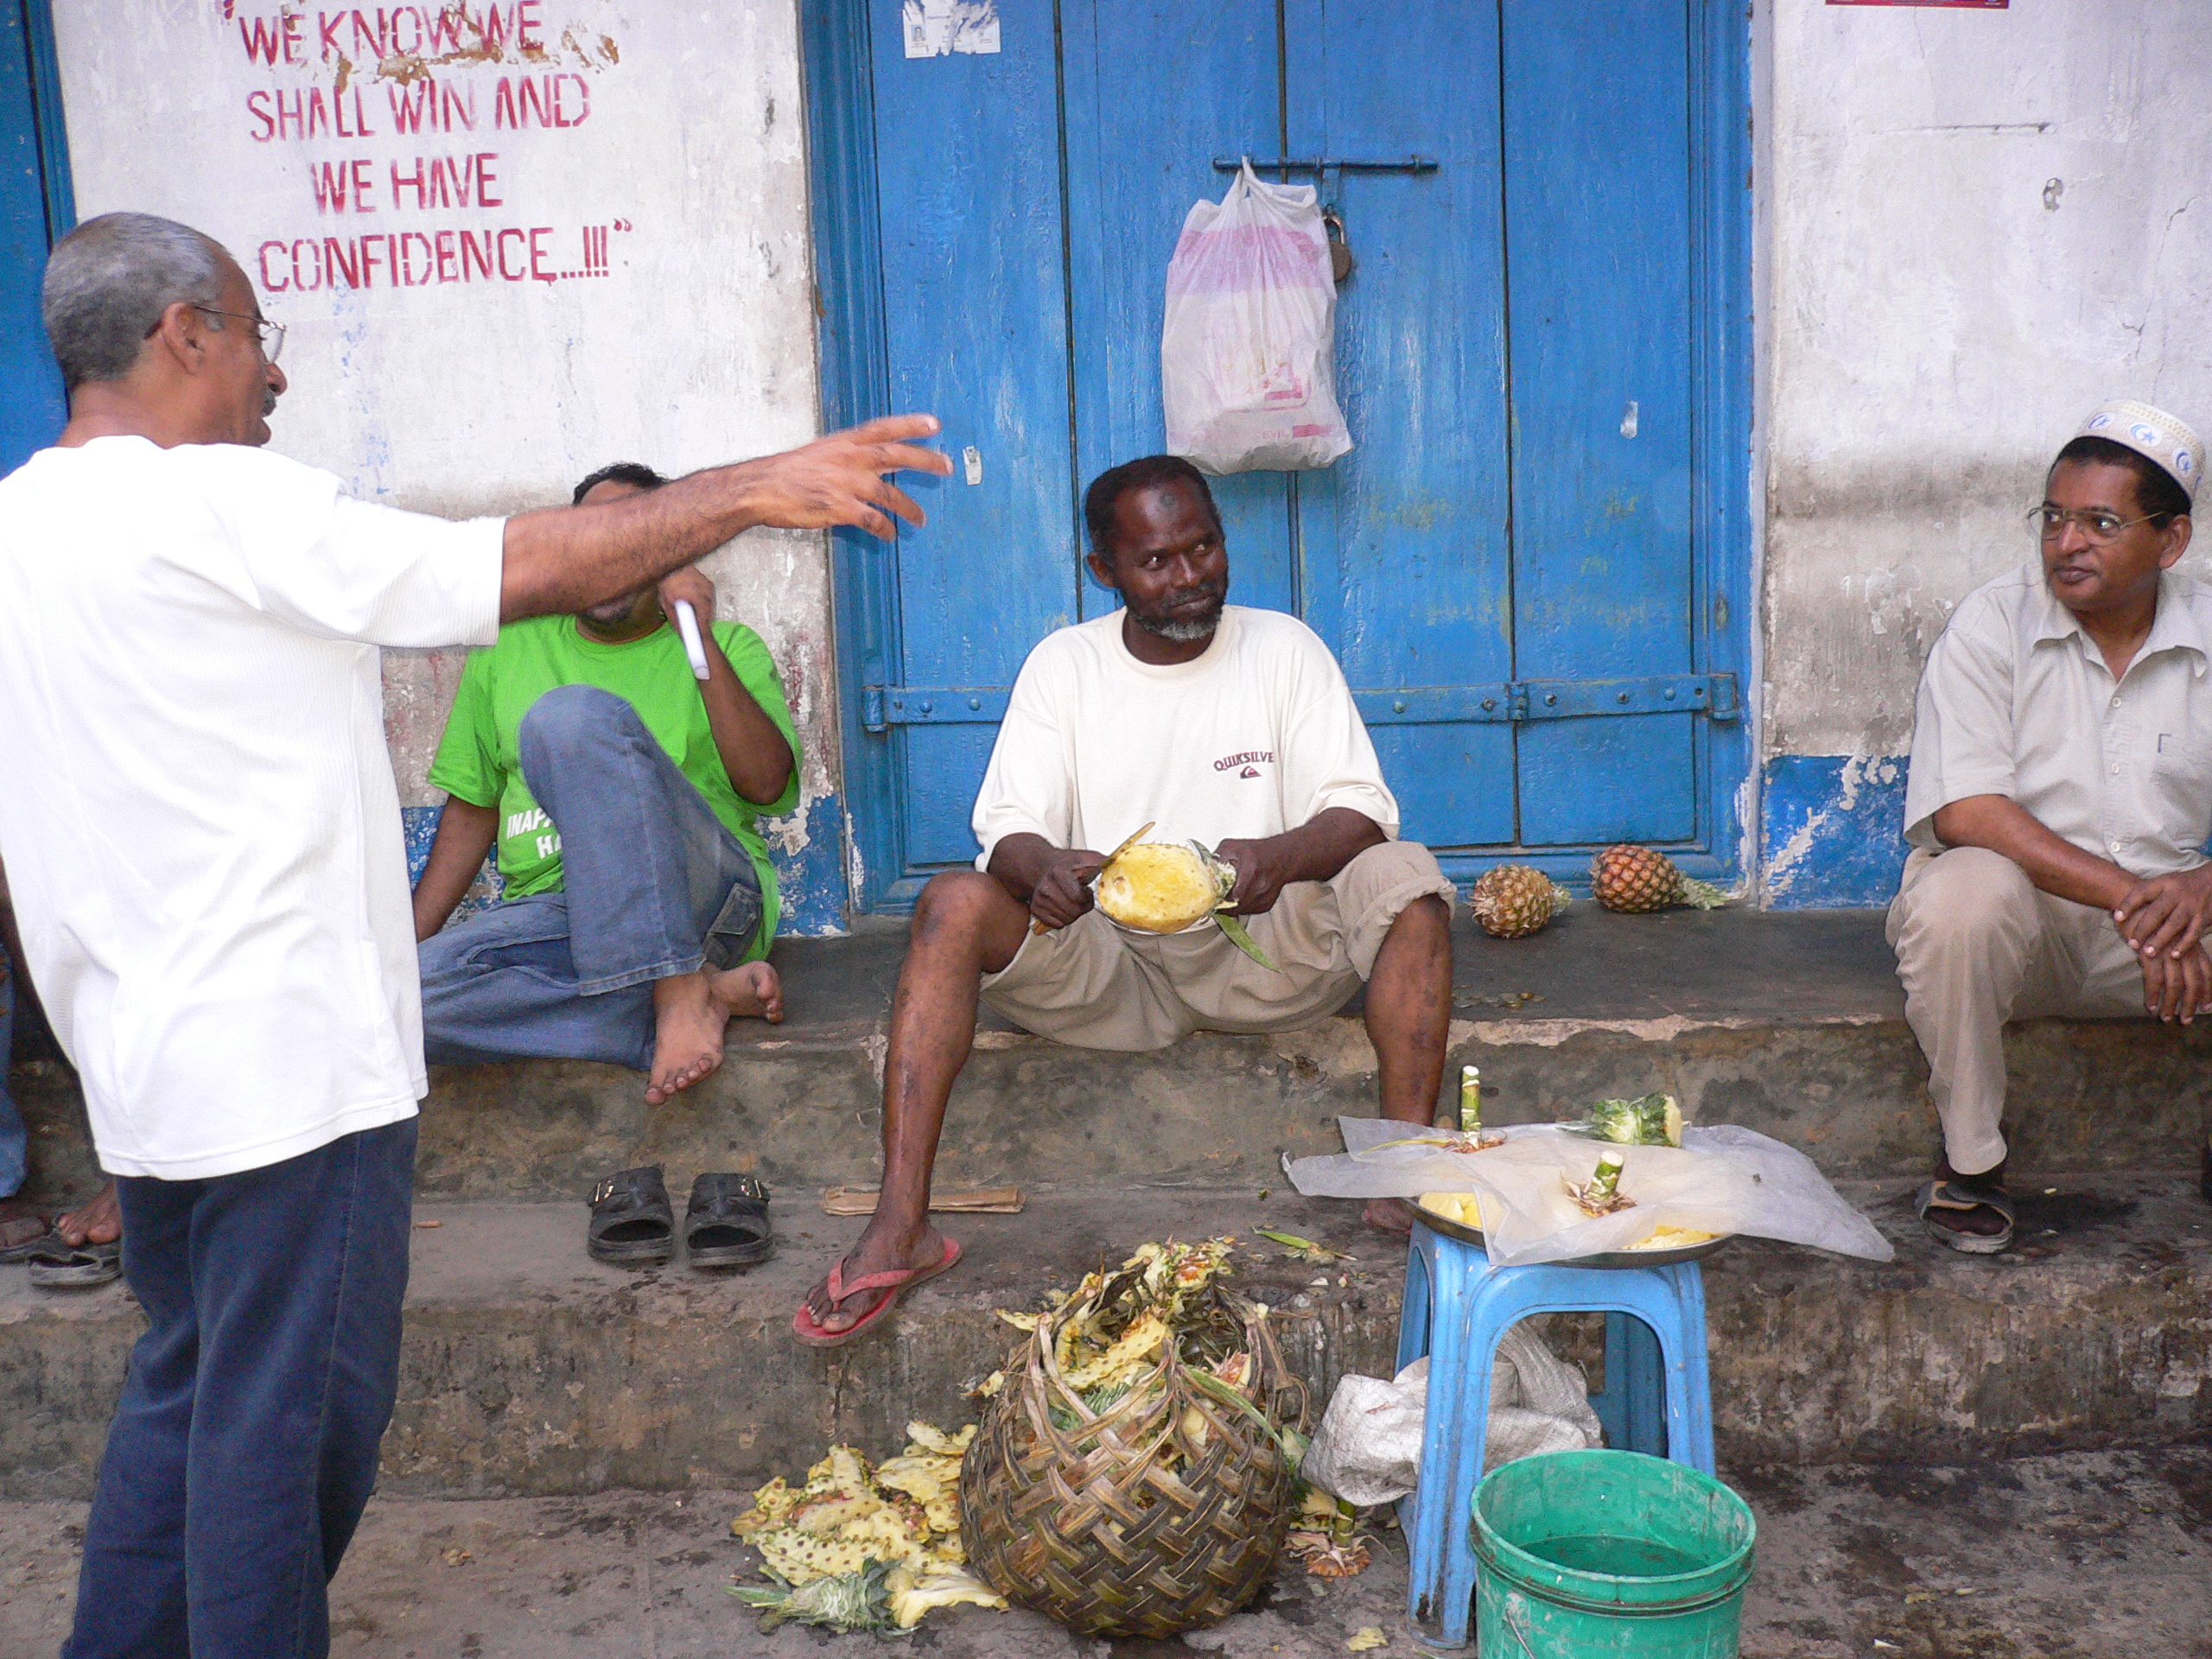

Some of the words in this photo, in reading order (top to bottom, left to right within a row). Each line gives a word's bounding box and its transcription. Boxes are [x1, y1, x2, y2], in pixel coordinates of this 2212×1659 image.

[475, 0, 545, 52] WE
[247, 86, 377, 143] SHALL
[388, 77, 476, 135] WIN
[495, 73, 591, 130] AND
[309, 159, 377, 214] WE
[391, 152, 504, 210] HAVE
[1213, 751, 1274, 772] QUIKSILVE
